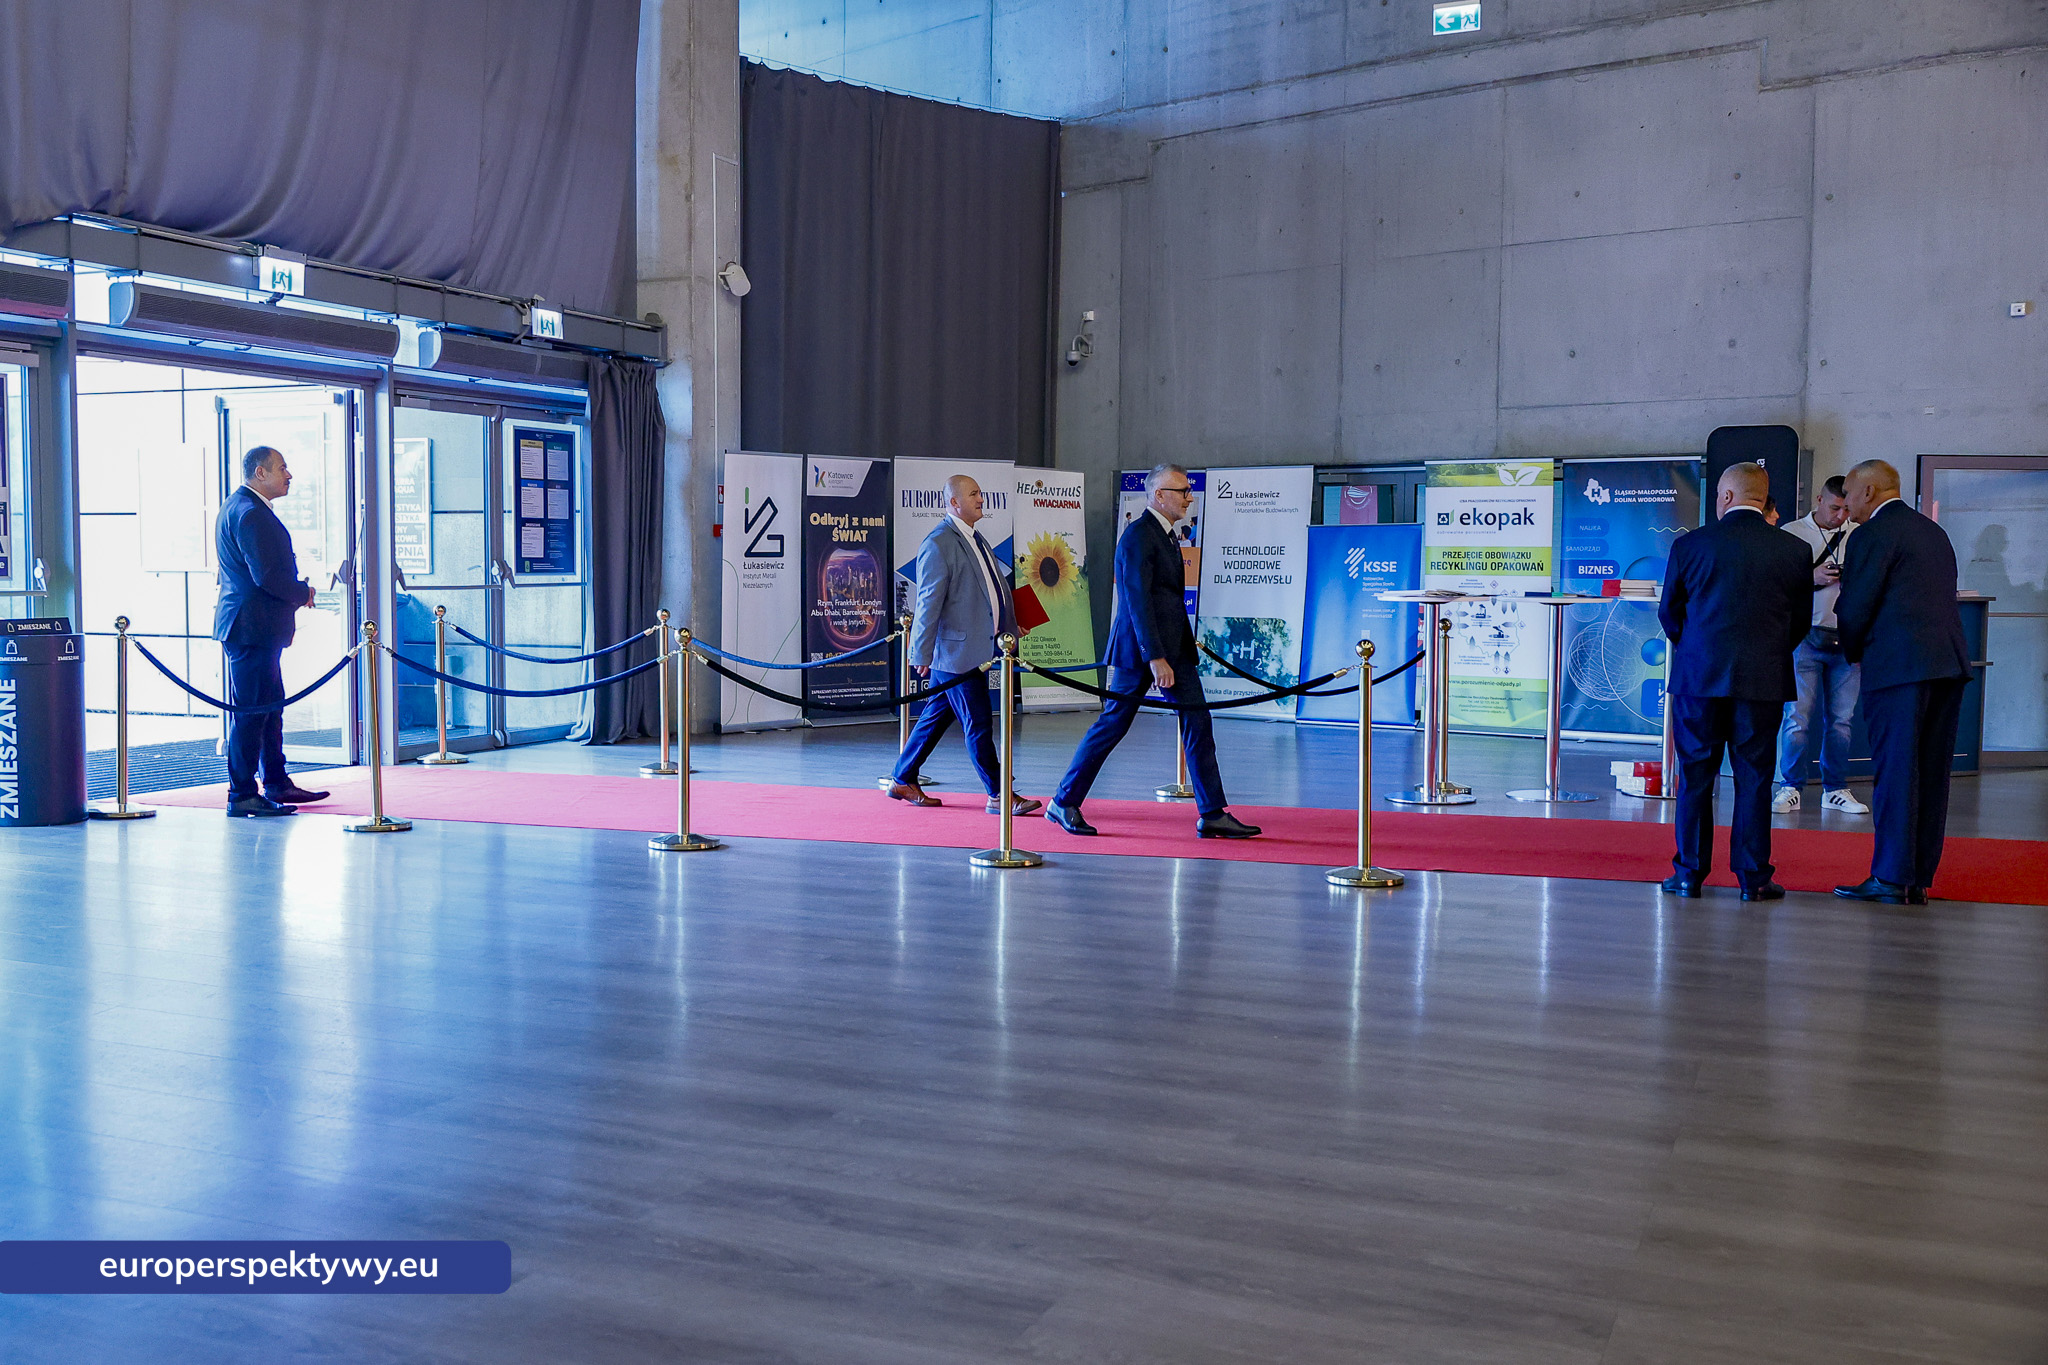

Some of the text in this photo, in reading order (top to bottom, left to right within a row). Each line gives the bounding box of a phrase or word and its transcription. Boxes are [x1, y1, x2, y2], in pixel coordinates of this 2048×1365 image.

[828, 471, 854, 480] Katowice
[1016, 481, 1081, 498] HELIANTHUS
[1235, 491, 1280, 499] Łukasiewicz
[1033, 498, 1081, 510] KWIACIARNIA
[810, 512, 886, 528] Odkryj z nami
[1459, 507, 1535, 531] ekopak
[832, 527, 869, 543] ŚWIAT
[1222, 546, 1286, 556] TECHNOLOGIE
[1442, 551, 1532, 561] PRZEJĘCIE OBOWIĄZKU
[743, 561, 785, 570] Łukasiewicz
[1223, 560, 1282, 570] WODOROWE
[1363, 561, 1398, 573] KSSE
[1430, 560, 1544, 572] RECYKLINGU OPAKOWAŃ
[1578, 565, 1614, 575] BIZNES
[1214, 574, 1292, 585] DLA PRZEMYSŁU
[17, 623, 52, 631] ZMIESZANE
[0, 679, 19, 819] ZMIESZANE
